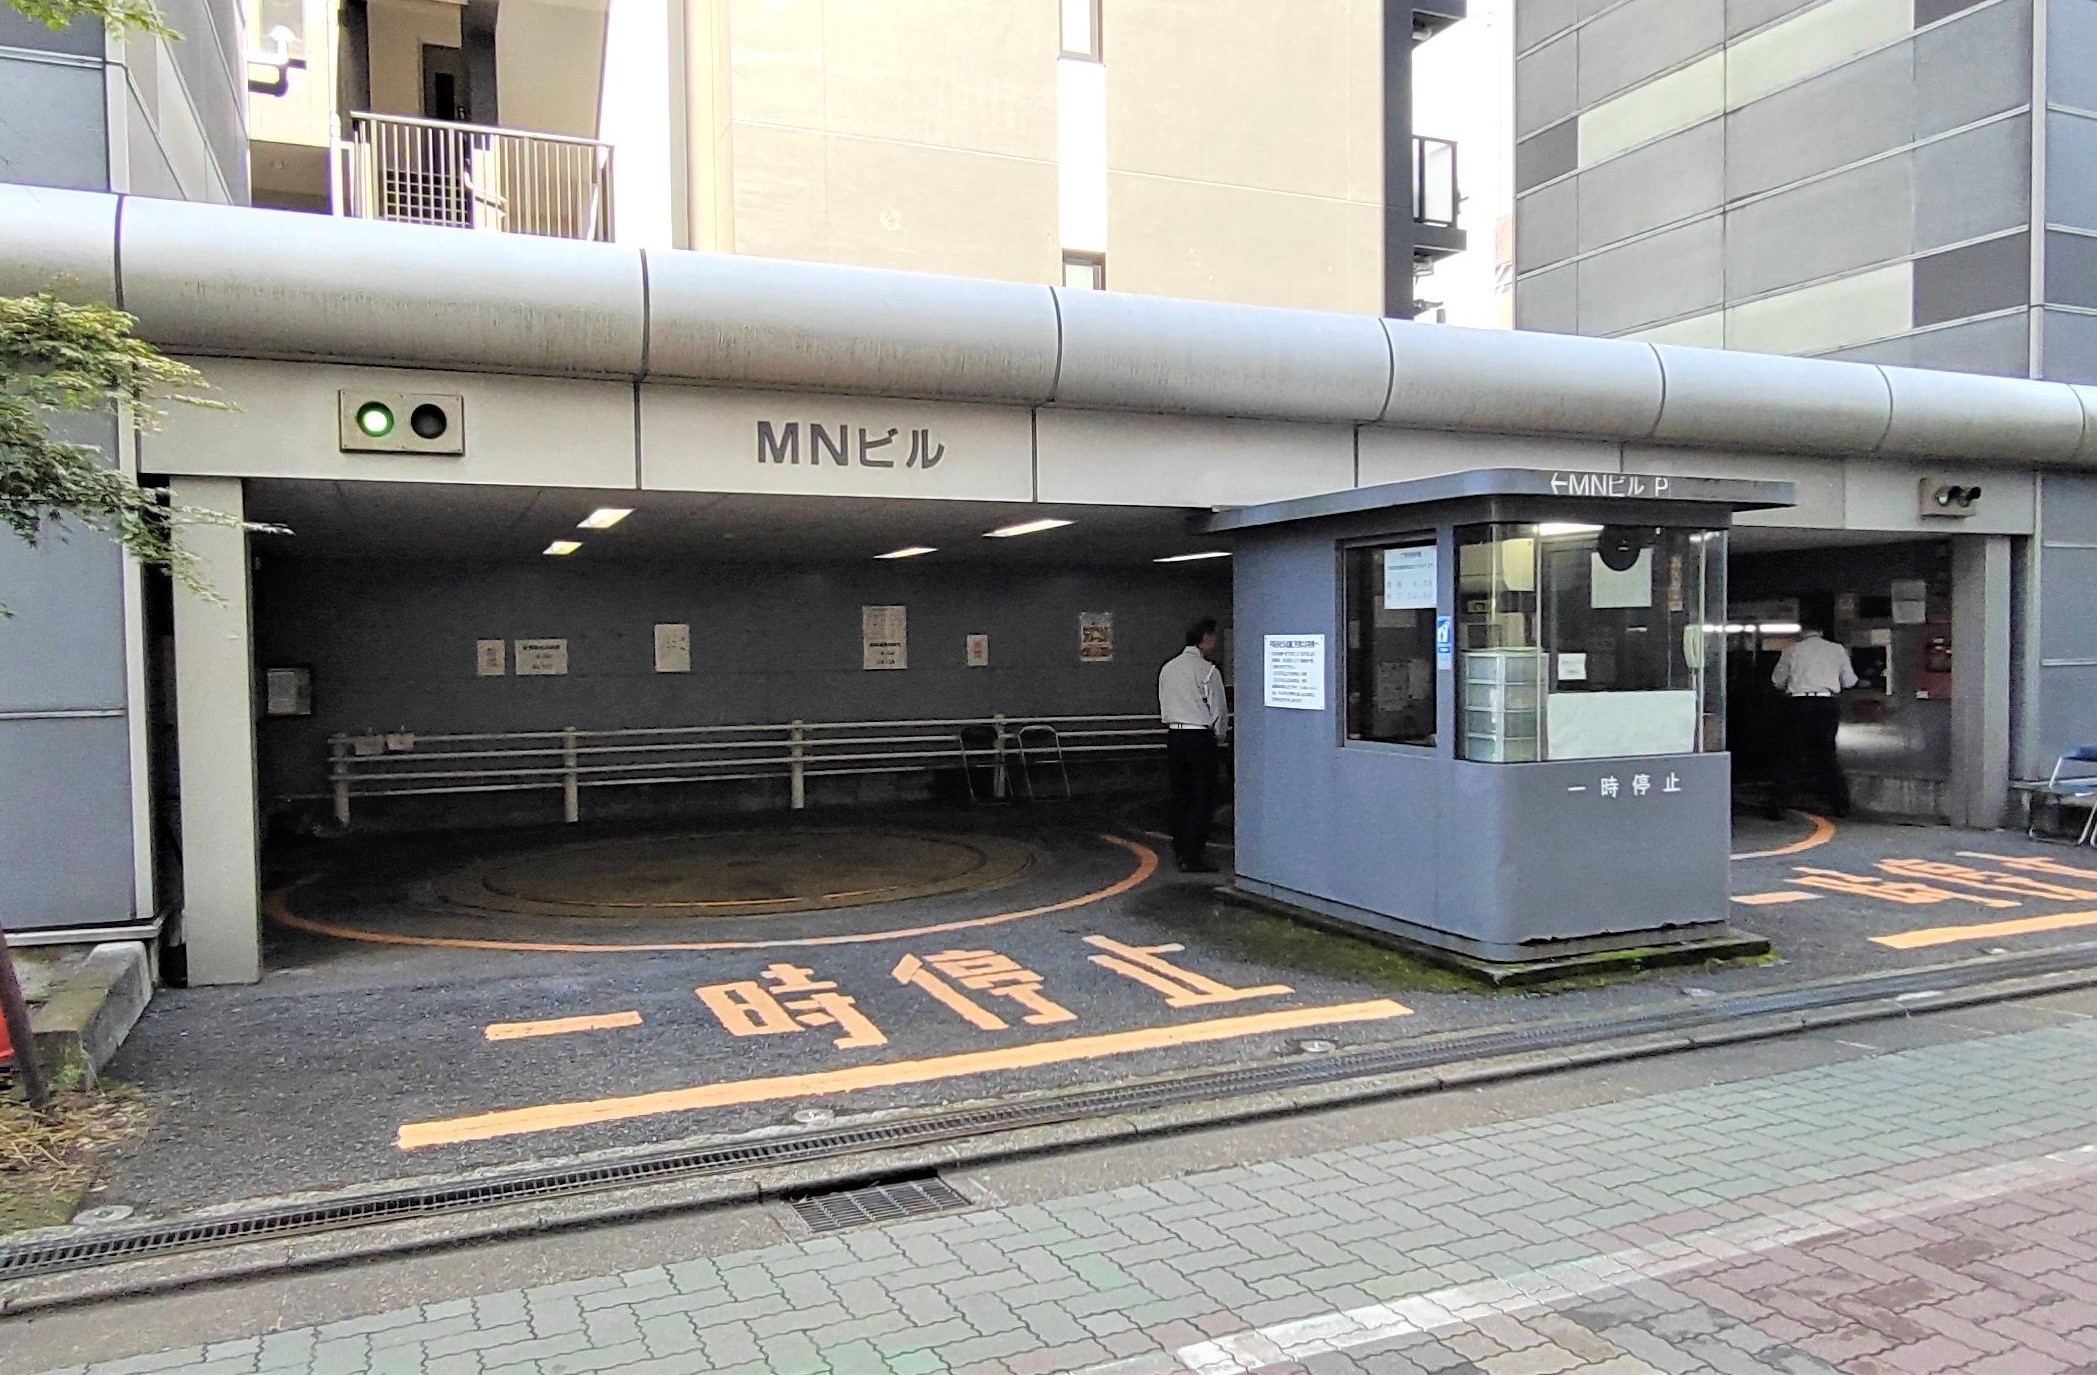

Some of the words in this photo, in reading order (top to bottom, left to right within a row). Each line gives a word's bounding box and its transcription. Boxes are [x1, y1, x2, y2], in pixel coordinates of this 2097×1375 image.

[757, 420, 945, 470] MNビル
[1568, 473, 1646, 498] MNビル
[1654, 477, 1669, 498] P
[1567, 771, 1682, 799] 一時停止
[483, 934, 1297, 1050] 一時停止
